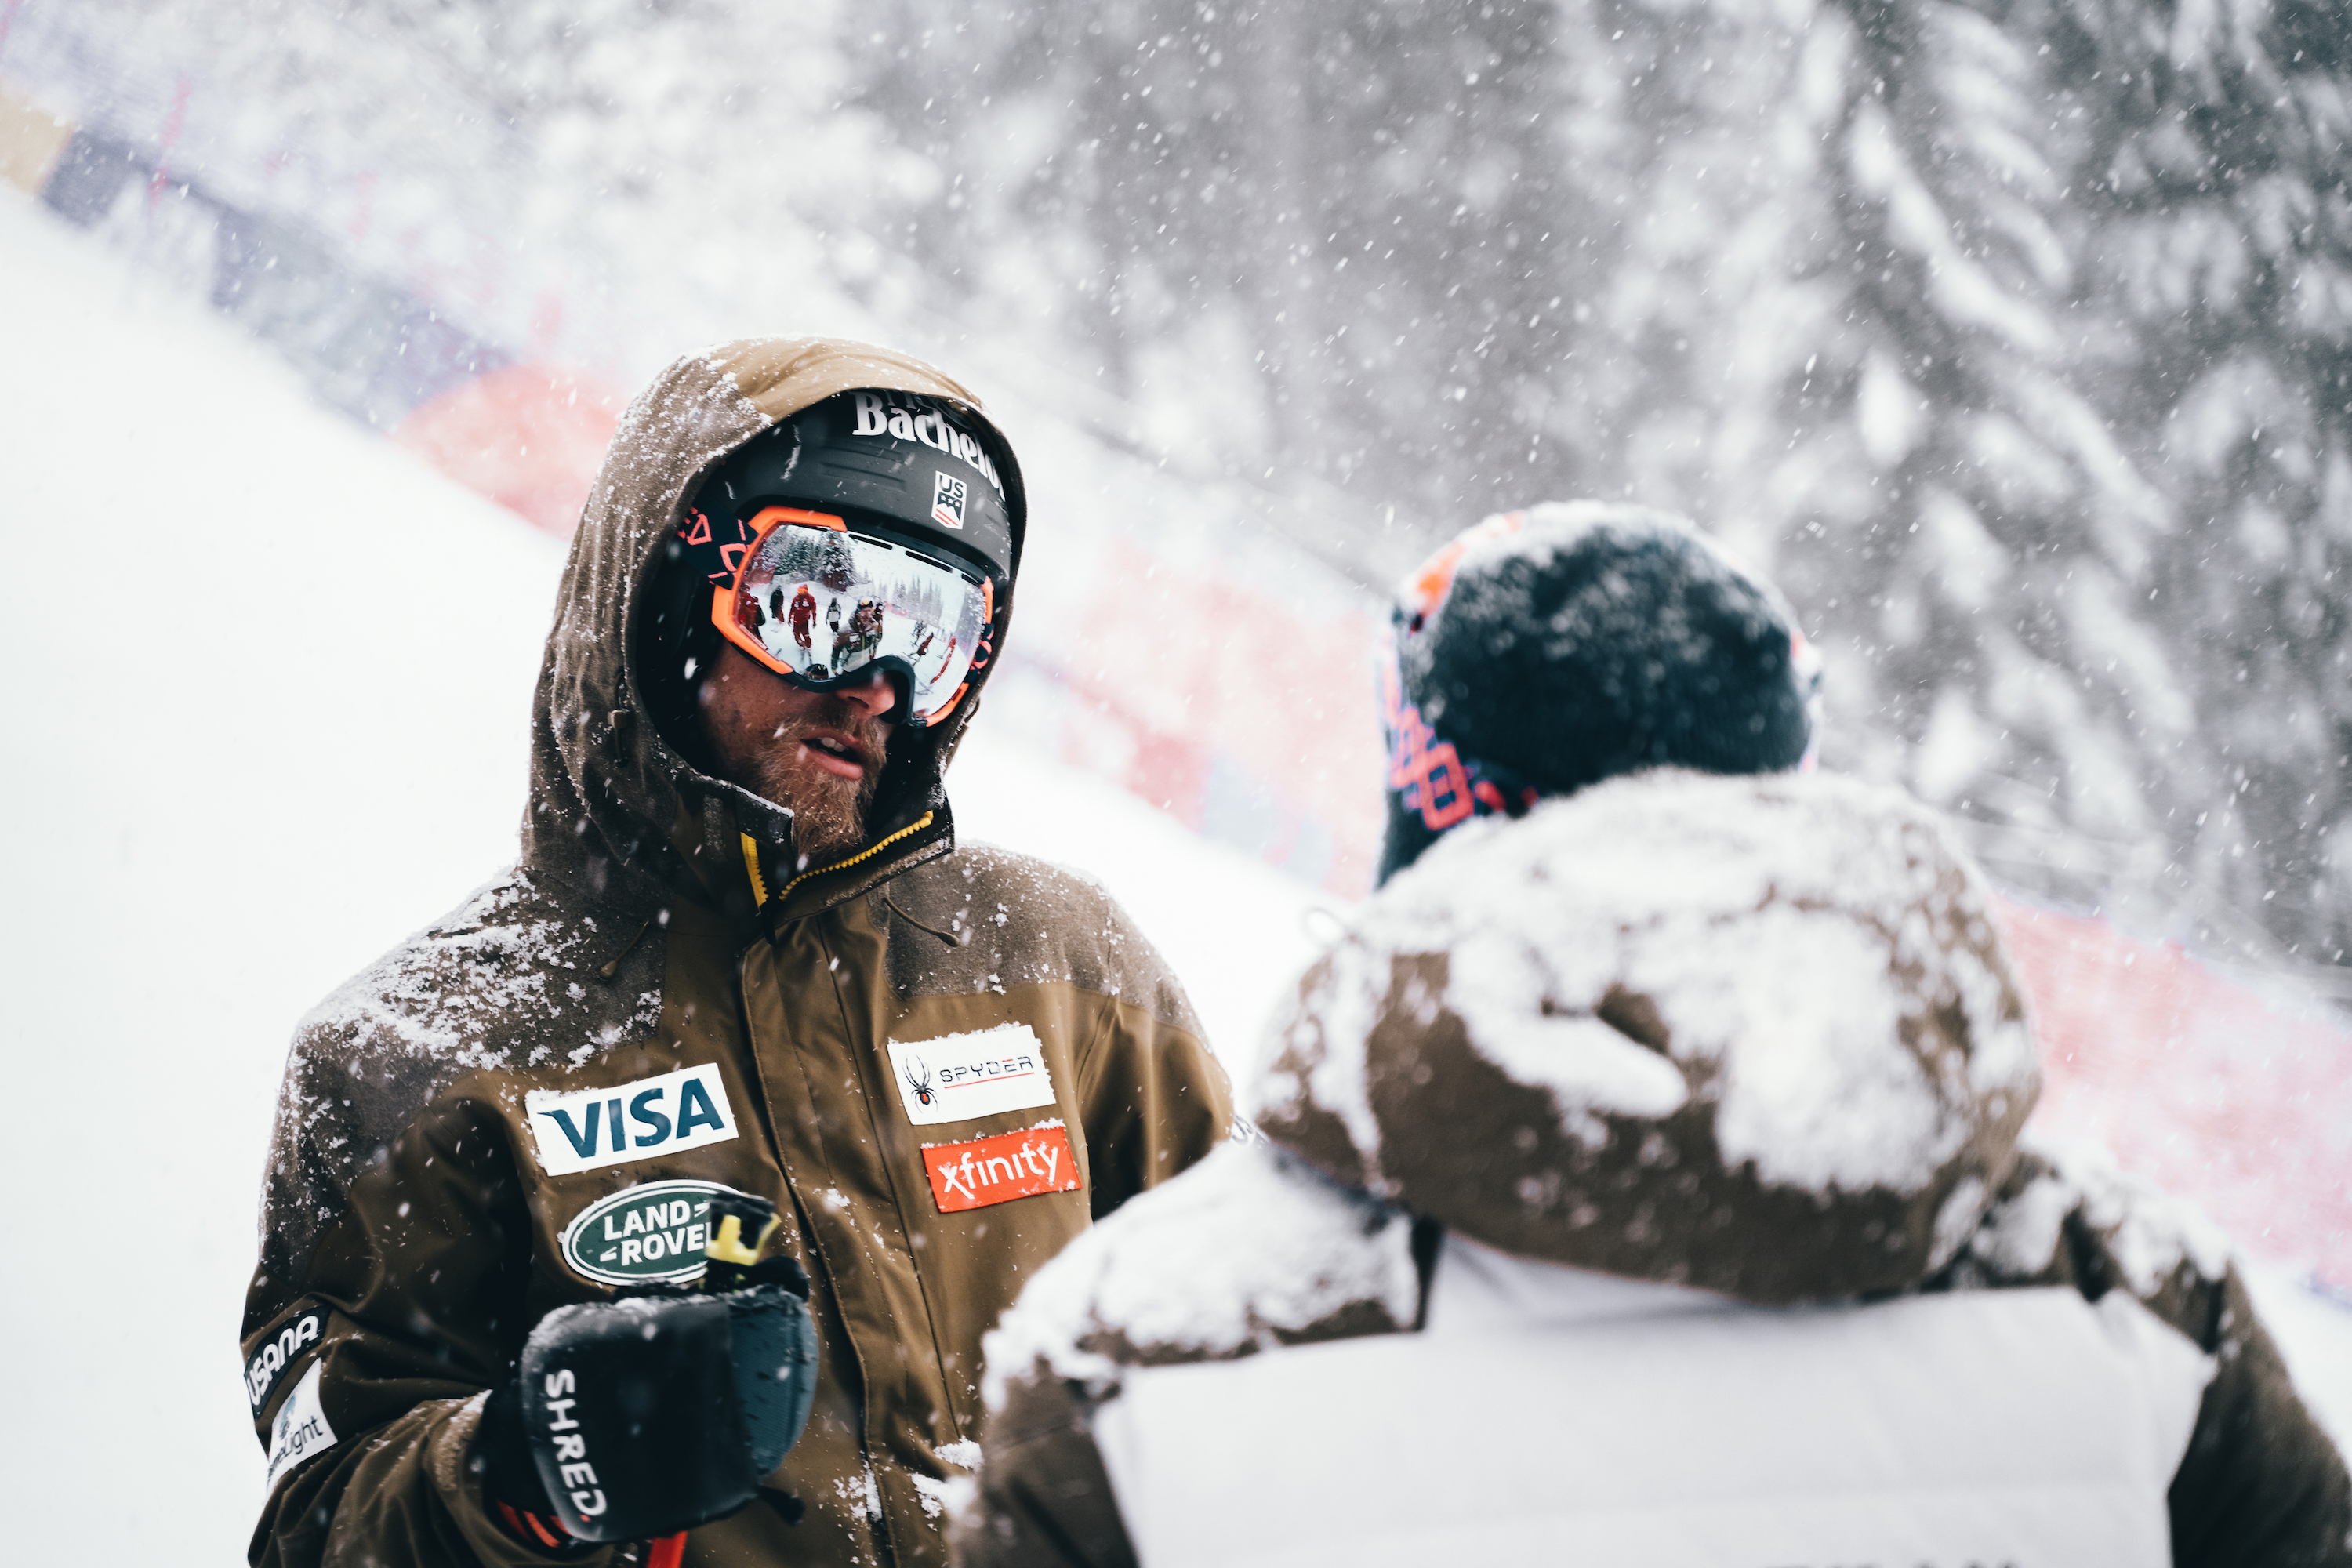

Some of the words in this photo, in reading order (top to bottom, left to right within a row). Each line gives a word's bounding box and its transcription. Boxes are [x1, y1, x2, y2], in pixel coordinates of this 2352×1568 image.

[939, 474, 964, 499] US
[939, 1055, 1034, 1083] SPYDER
[537, 1078, 726, 1159] VISA
[938, 1142, 1059, 1200] xfinity
[604, 1200, 690, 1242] LAND
[621, 1221, 711, 1267] ROVE
[246, 1314, 320, 1406] USANA
